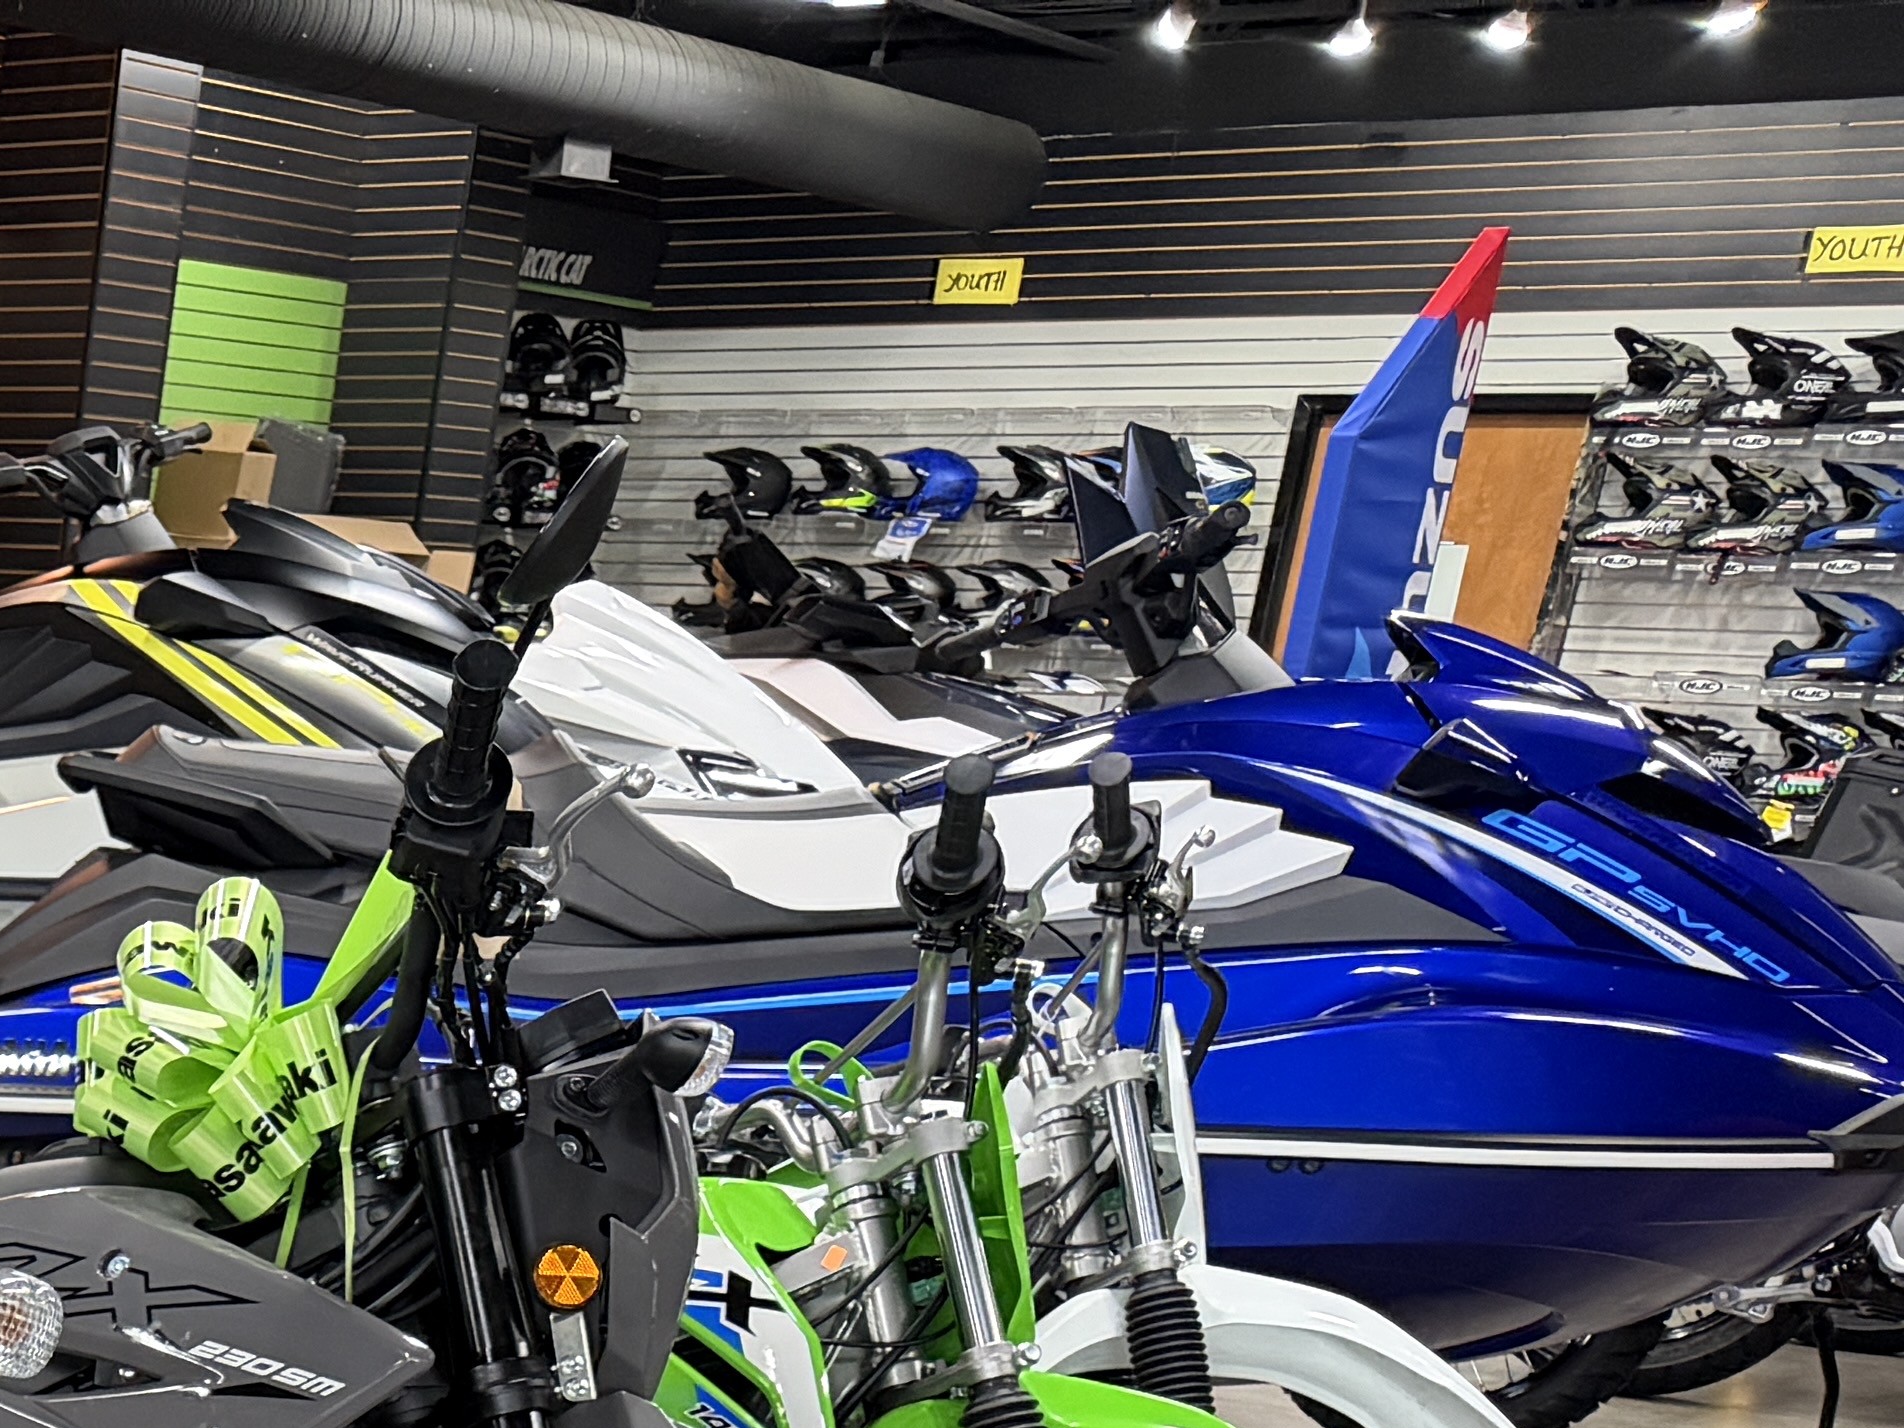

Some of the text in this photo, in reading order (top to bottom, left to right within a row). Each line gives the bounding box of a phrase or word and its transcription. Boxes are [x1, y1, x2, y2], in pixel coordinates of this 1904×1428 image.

[1812, 233, 1904, 262] YOUTH
[943, 269, 1007, 292] YOUTH
[1482, 808, 1642, 884] GP
[1628, 885, 1791, 983] SVHO
[190, 1340, 347, 1397] 230SM
